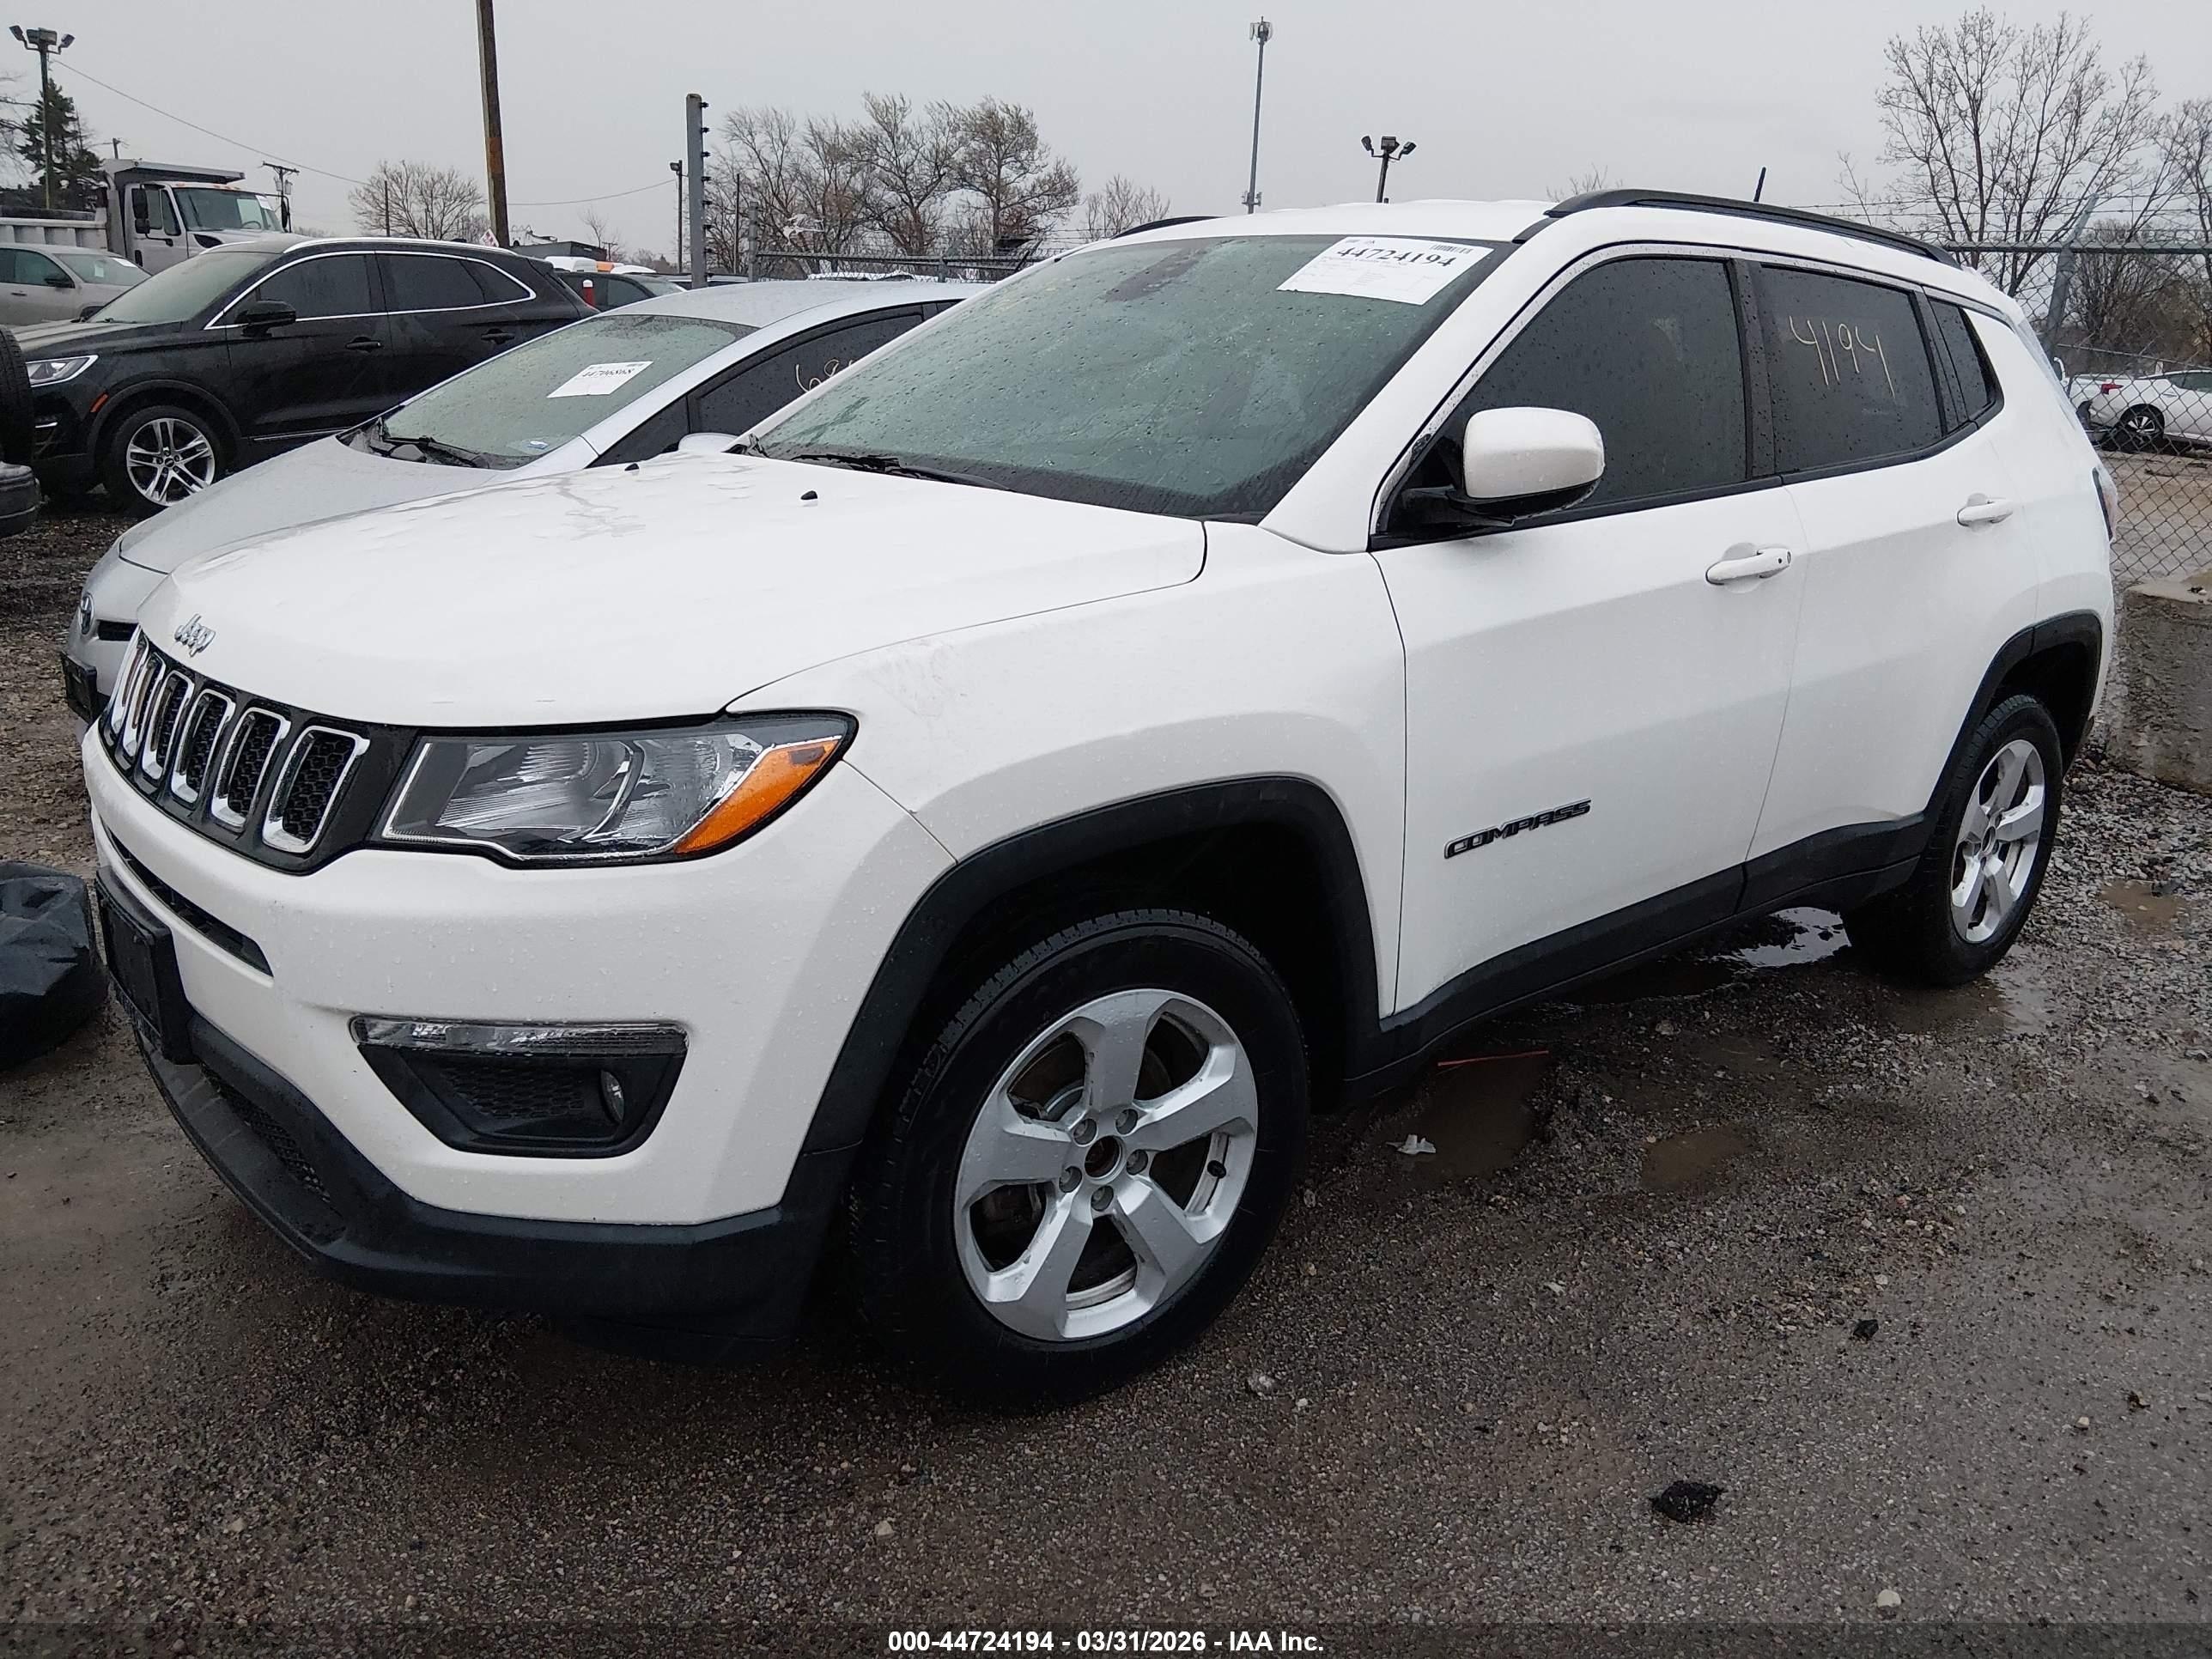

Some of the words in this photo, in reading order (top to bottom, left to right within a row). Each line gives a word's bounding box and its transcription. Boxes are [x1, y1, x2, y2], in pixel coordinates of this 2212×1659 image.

[1337, 246, 1457, 267] 44724194
[1789, 315, 1895, 398] 4194
[174, 612, 216, 657] Jeep
[1444, 798, 1592, 859] COMPASS
